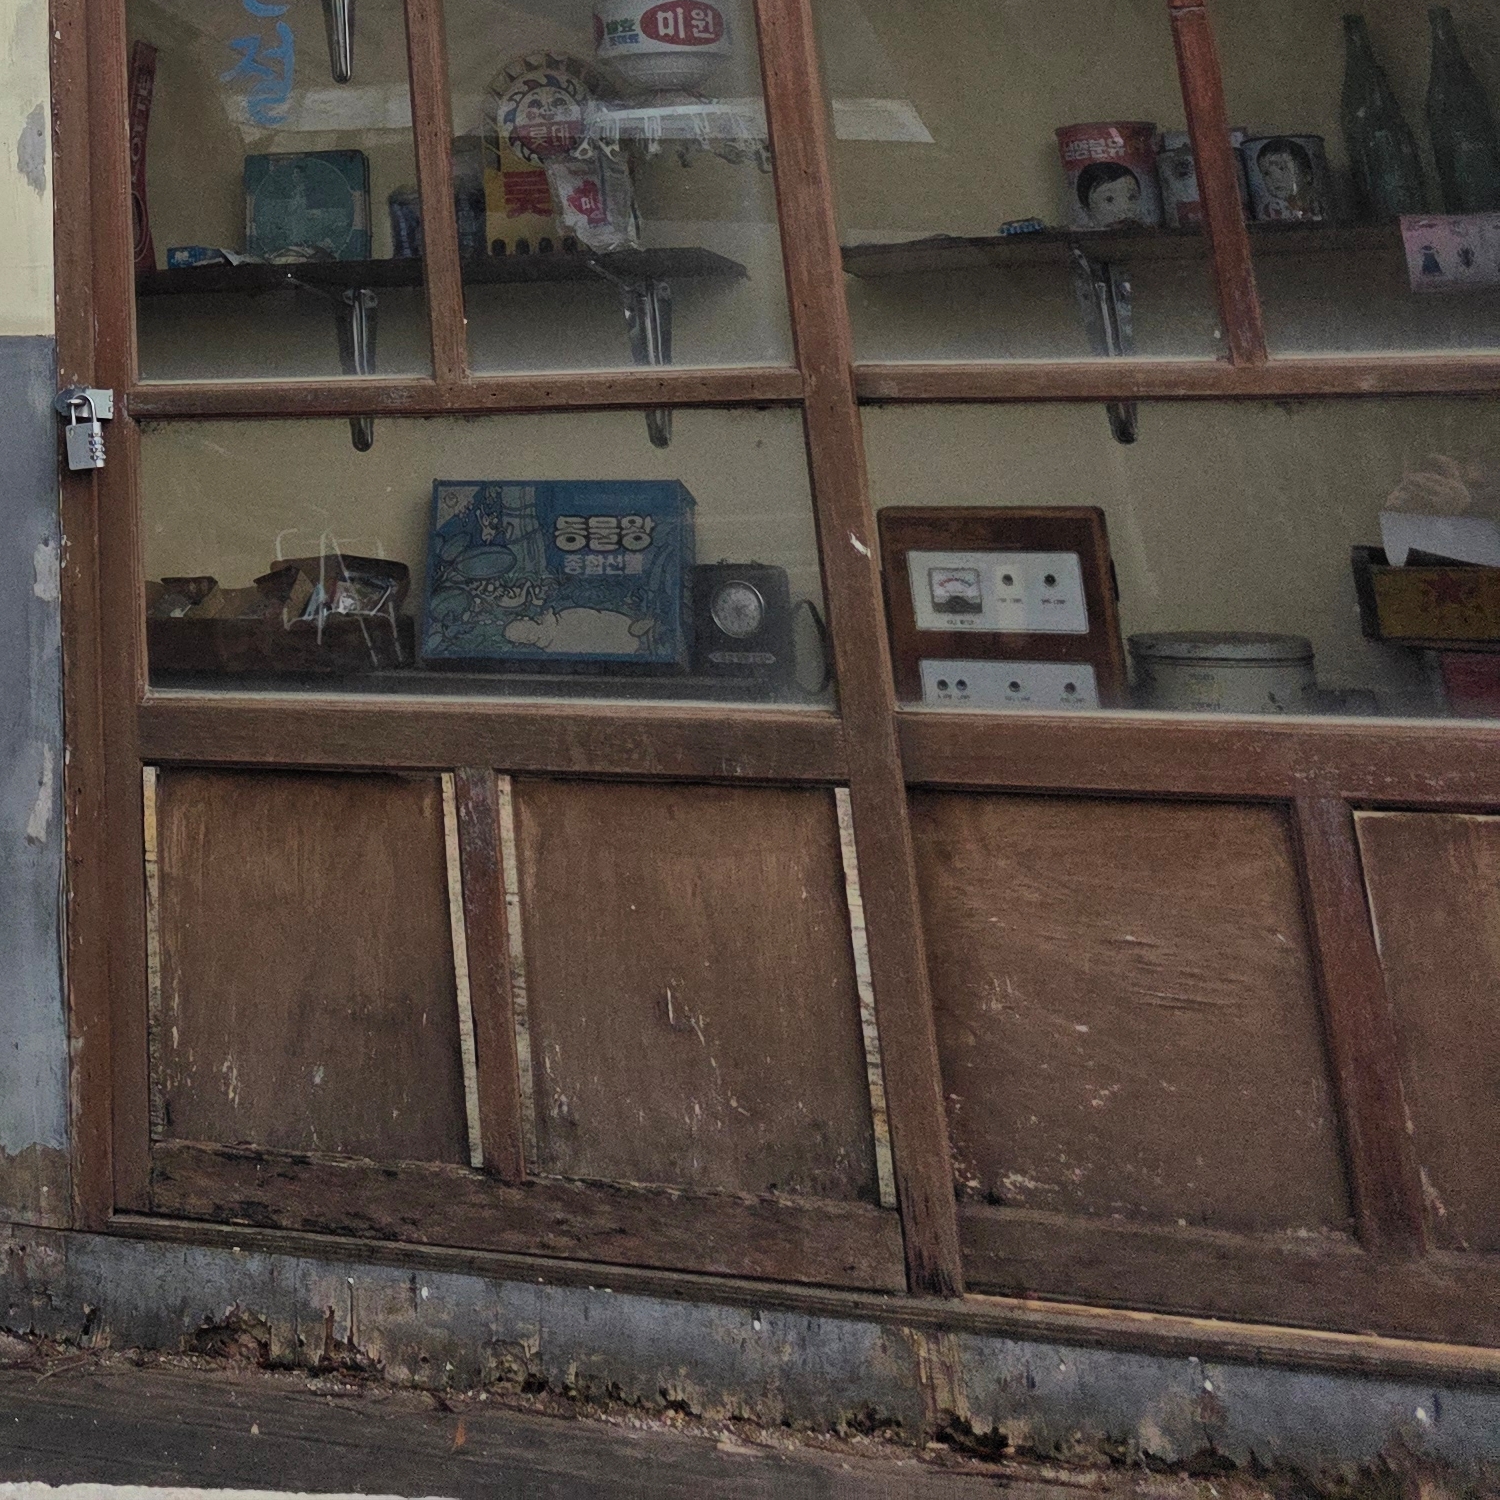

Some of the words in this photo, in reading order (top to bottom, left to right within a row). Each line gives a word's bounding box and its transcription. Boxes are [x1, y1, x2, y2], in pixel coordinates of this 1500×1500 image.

[656, 6, 716, 39] 미원
[553, 514, 655, 552] 동물왕
[563, 553, 644, 576] 종합선물
